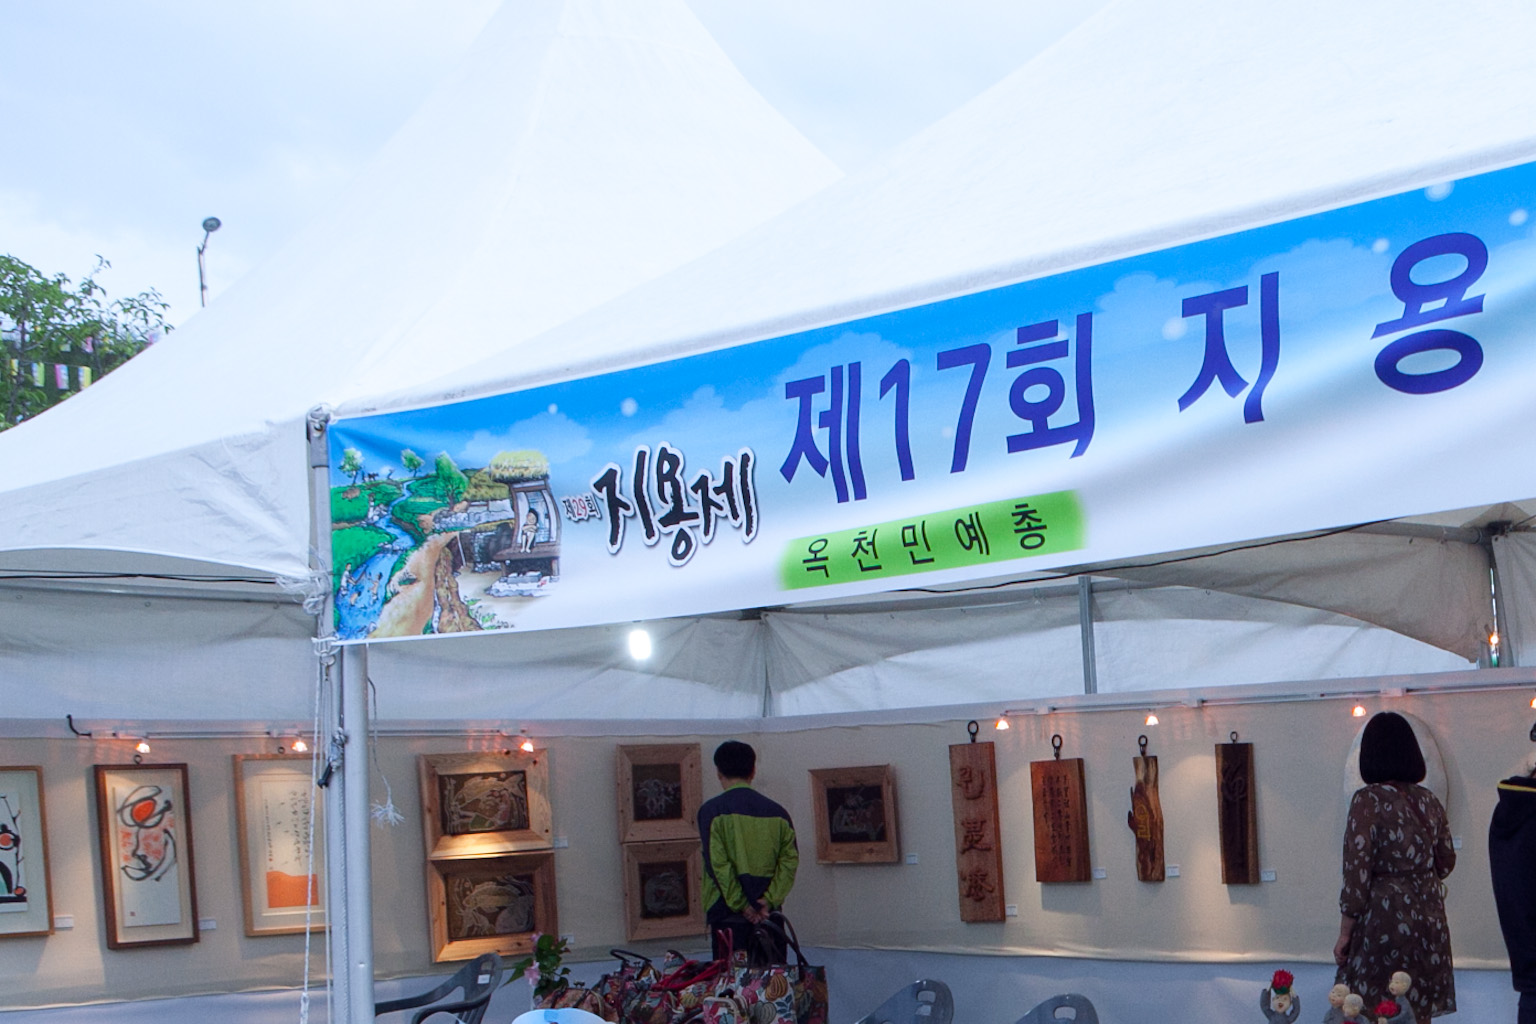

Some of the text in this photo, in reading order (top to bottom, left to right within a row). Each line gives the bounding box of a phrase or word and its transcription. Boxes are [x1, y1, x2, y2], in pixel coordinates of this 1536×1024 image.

[780, 311, 1095, 504] 제17회
[593, 446, 752, 561] 지용제
[802, 501, 1048, 578] 옥천민예총
